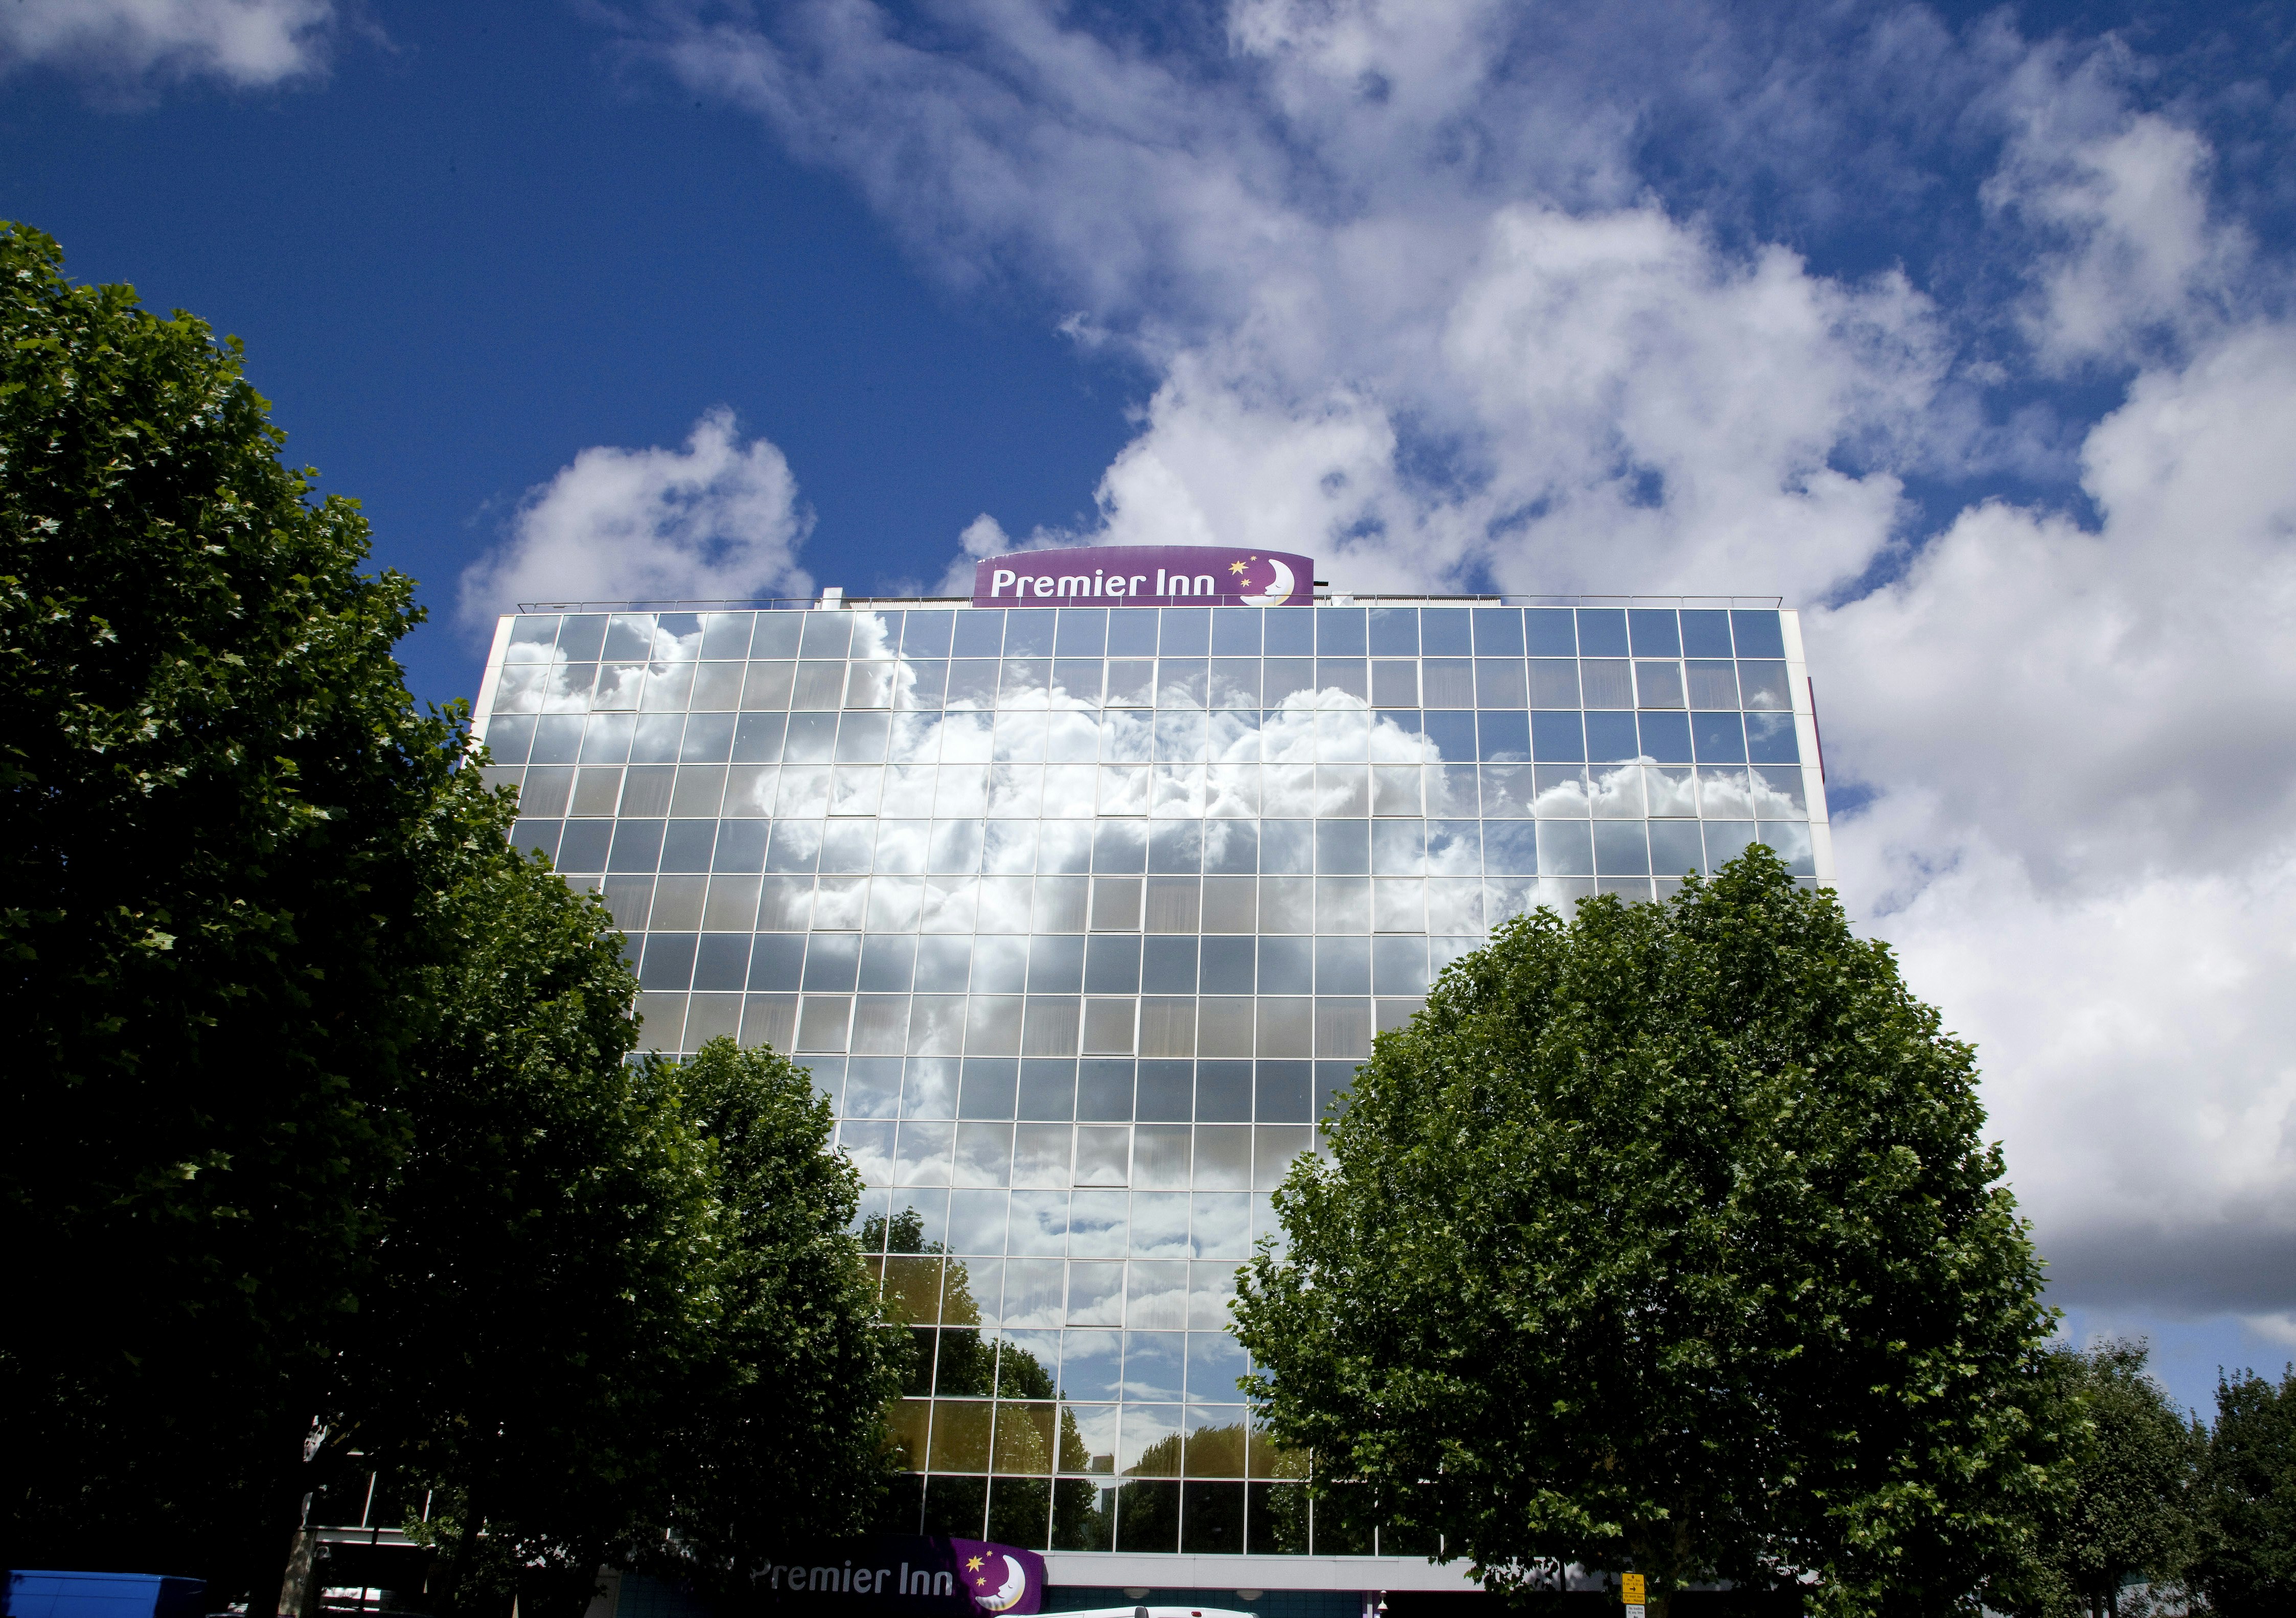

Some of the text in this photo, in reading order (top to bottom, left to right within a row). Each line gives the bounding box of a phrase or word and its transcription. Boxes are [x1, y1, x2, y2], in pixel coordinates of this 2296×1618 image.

[991, 568, 1214, 597] Premier Inn
[900, 1562, 953, 1596] Inn
